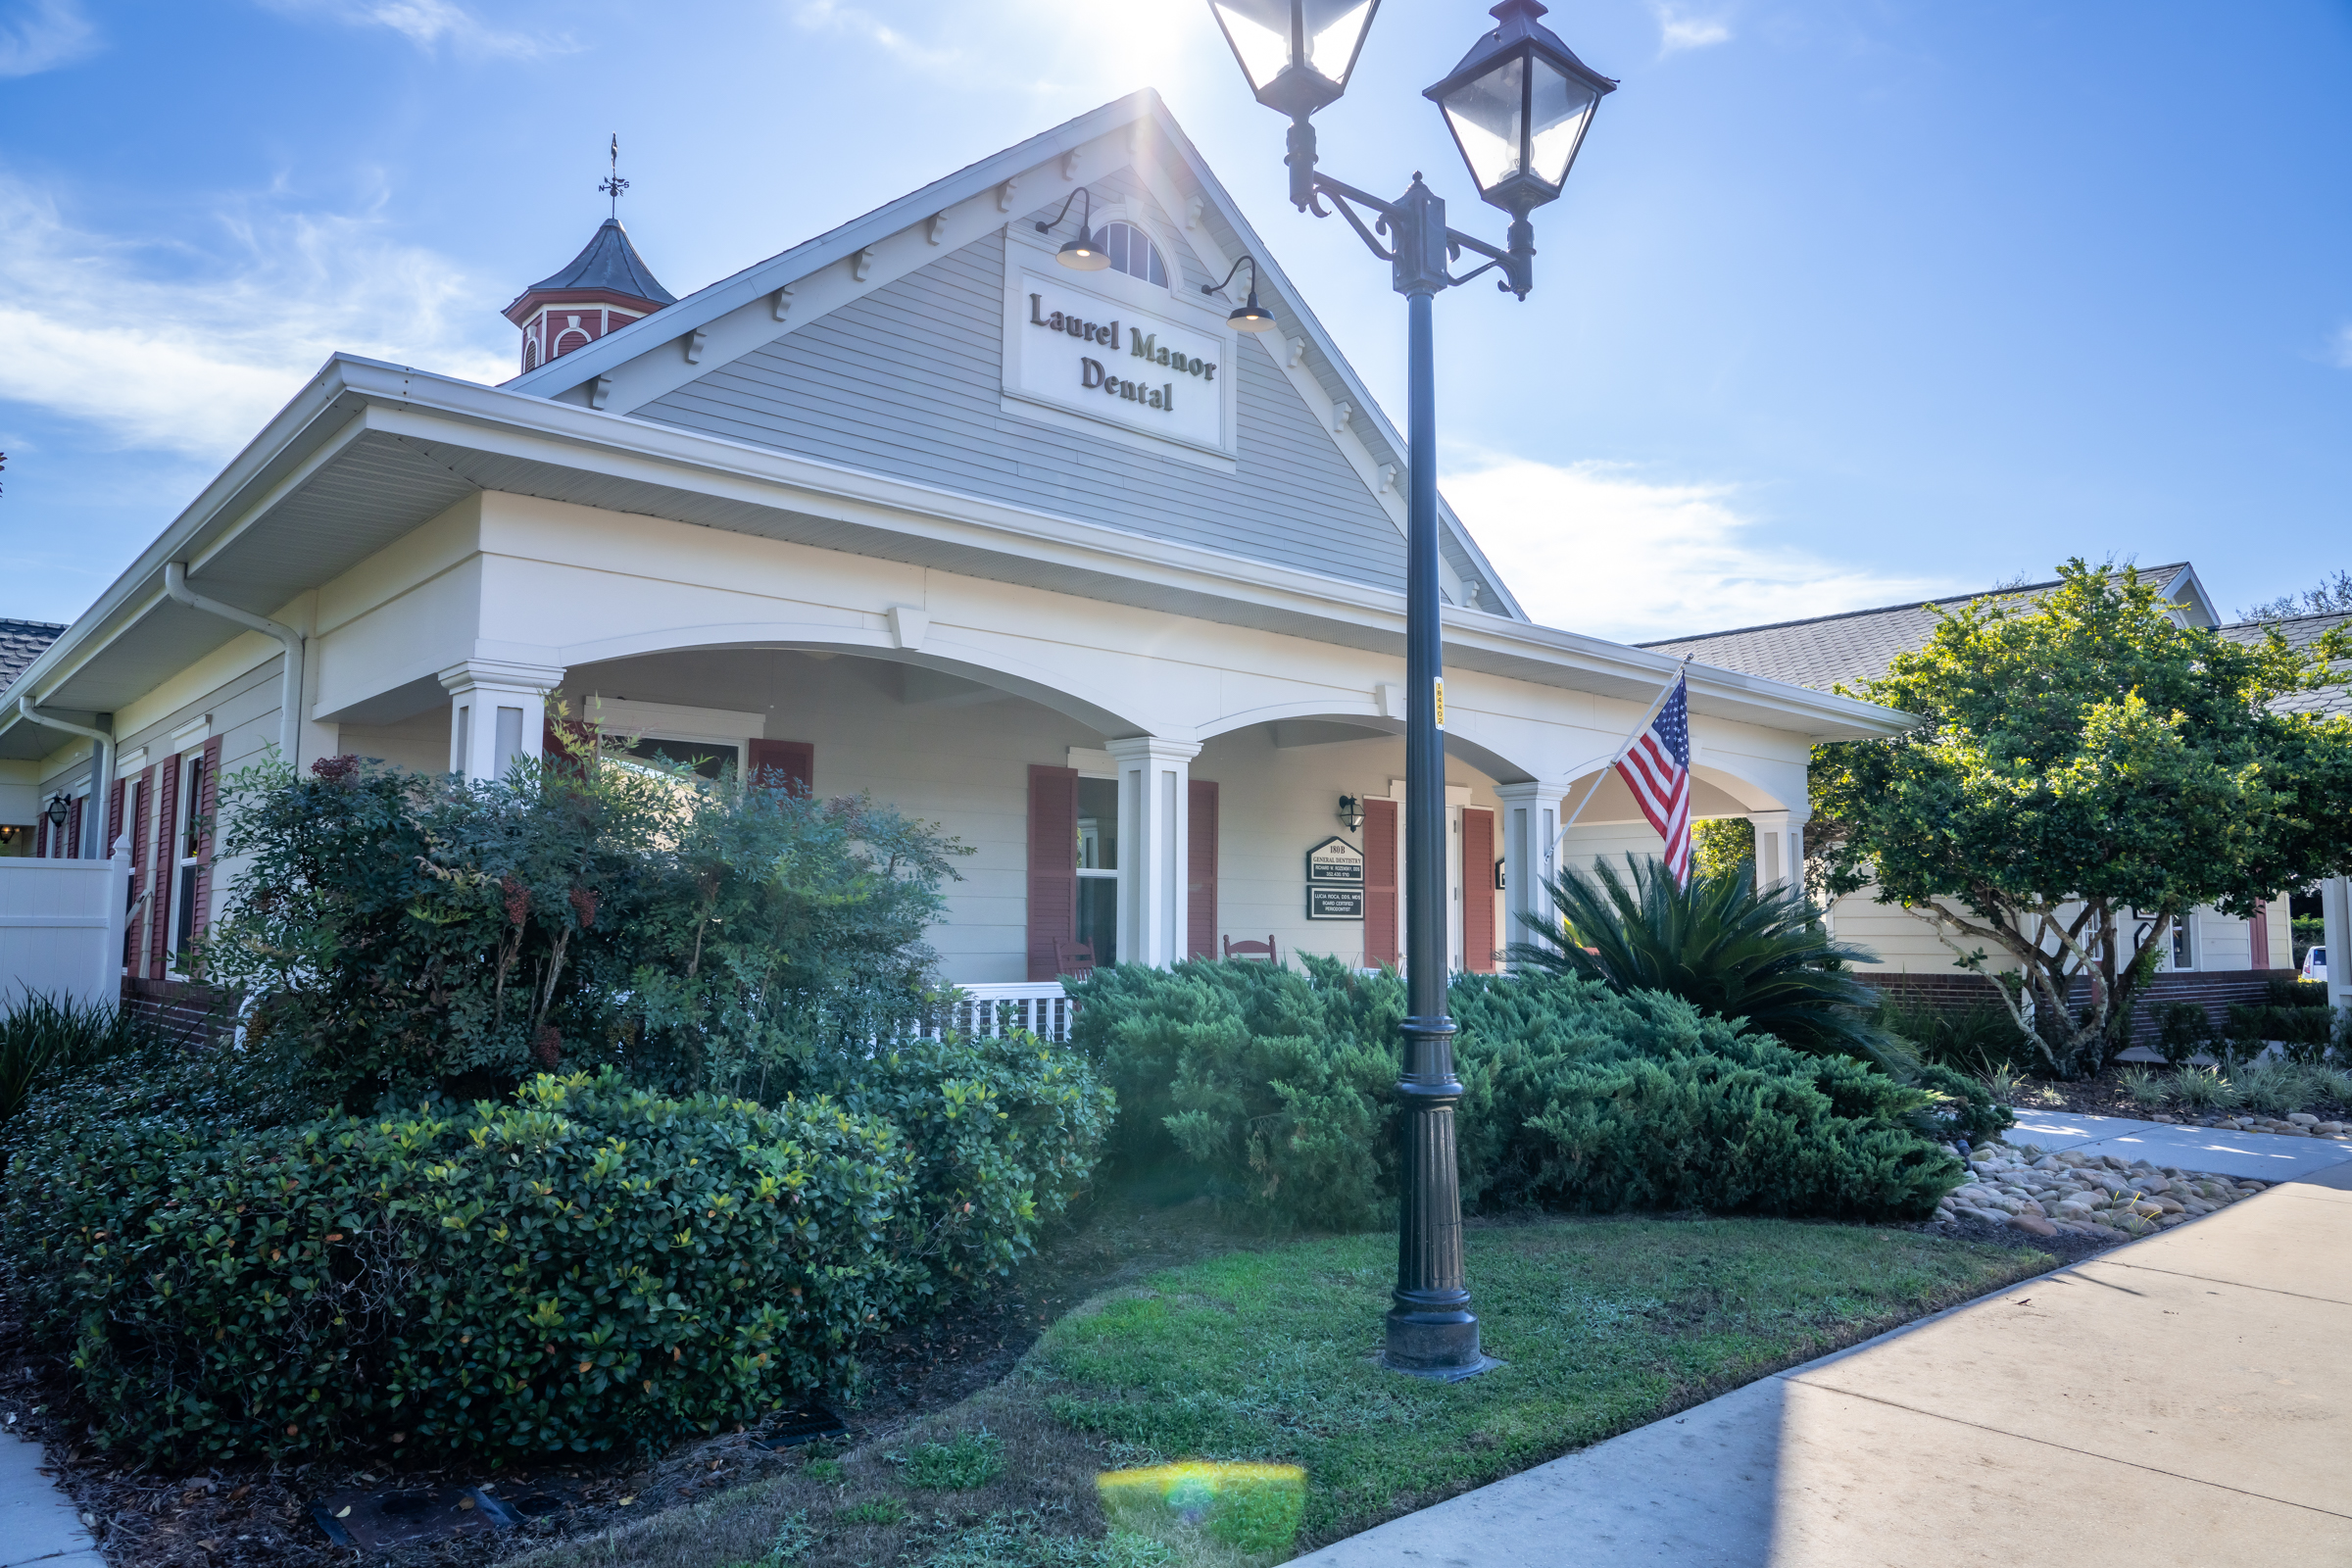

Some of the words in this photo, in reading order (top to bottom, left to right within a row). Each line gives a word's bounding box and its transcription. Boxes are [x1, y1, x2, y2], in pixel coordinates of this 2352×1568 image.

[1029, 293, 1120, 350] Laurel
[1130, 326, 1216, 381] Manor
[1081, 356, 1174, 412] Dental
